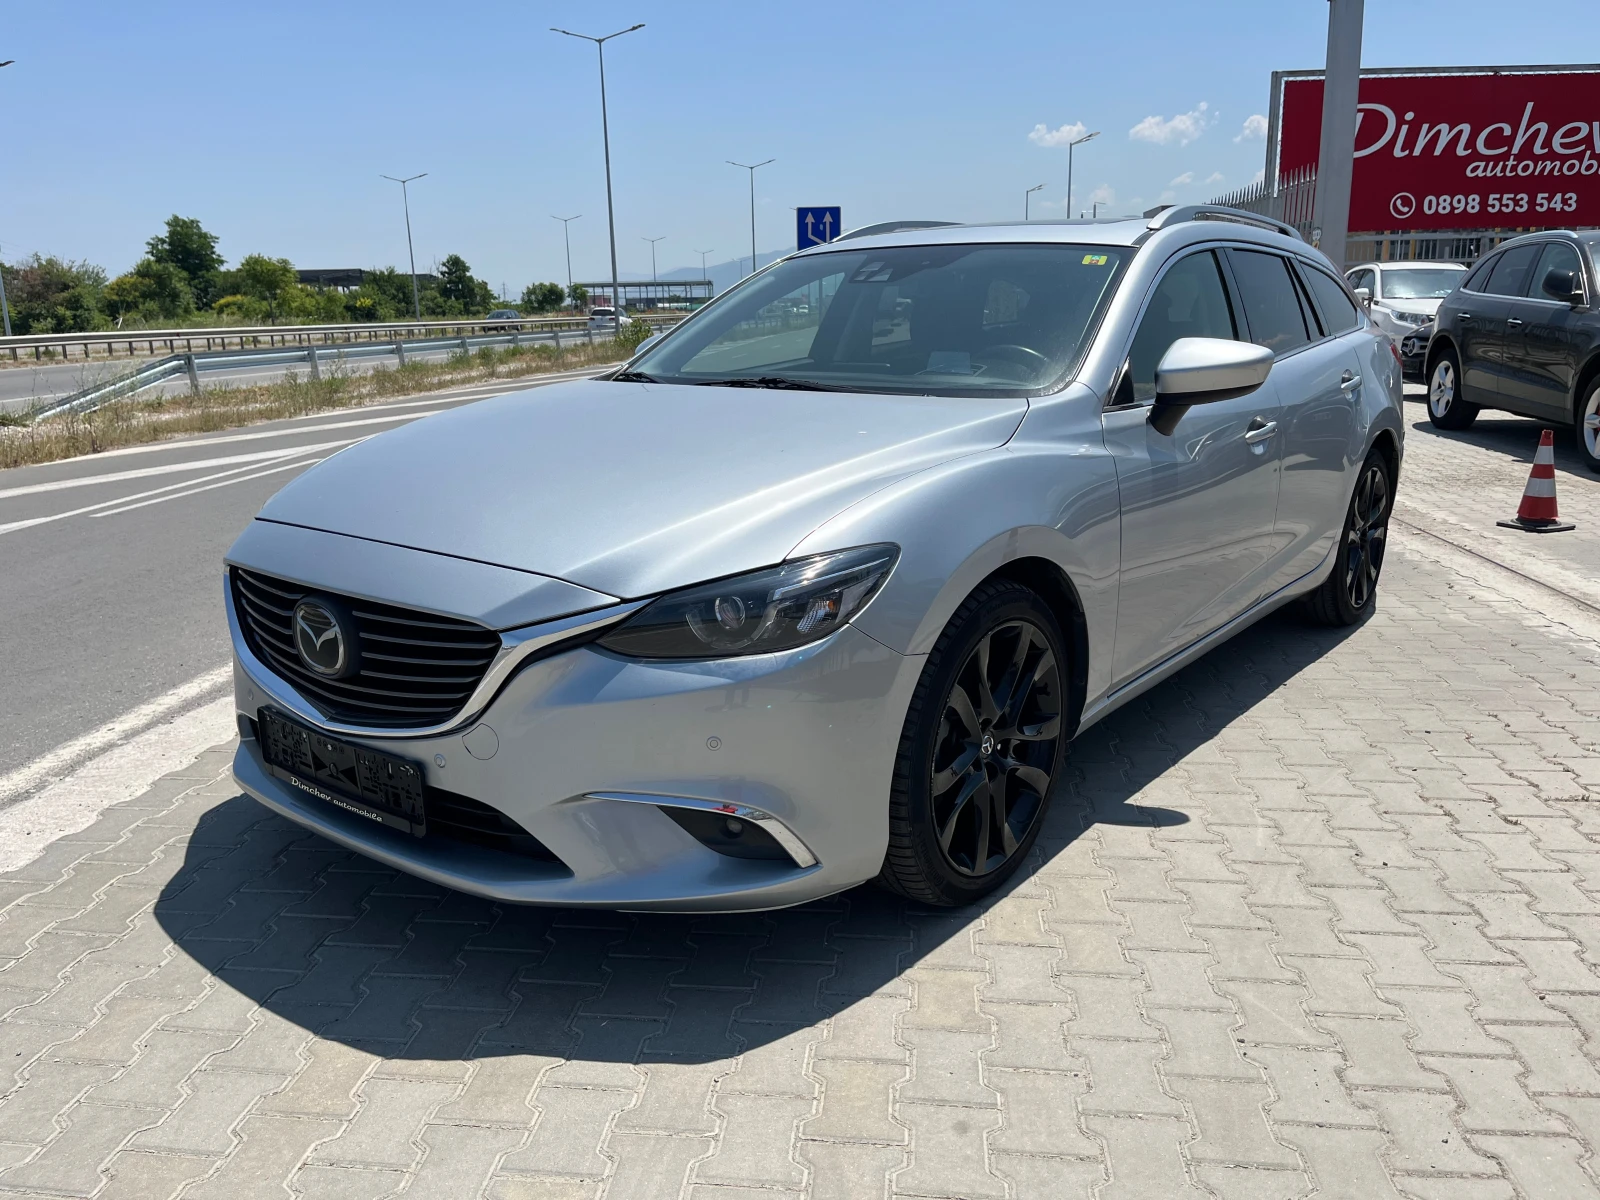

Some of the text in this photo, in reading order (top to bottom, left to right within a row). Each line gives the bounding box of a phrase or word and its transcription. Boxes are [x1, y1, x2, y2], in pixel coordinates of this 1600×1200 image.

[1466, 150, 1600, 177] automob
[1424, 193, 1576, 214] 0898 553 543
[291, 776, 383, 822] Dimchev automobile
